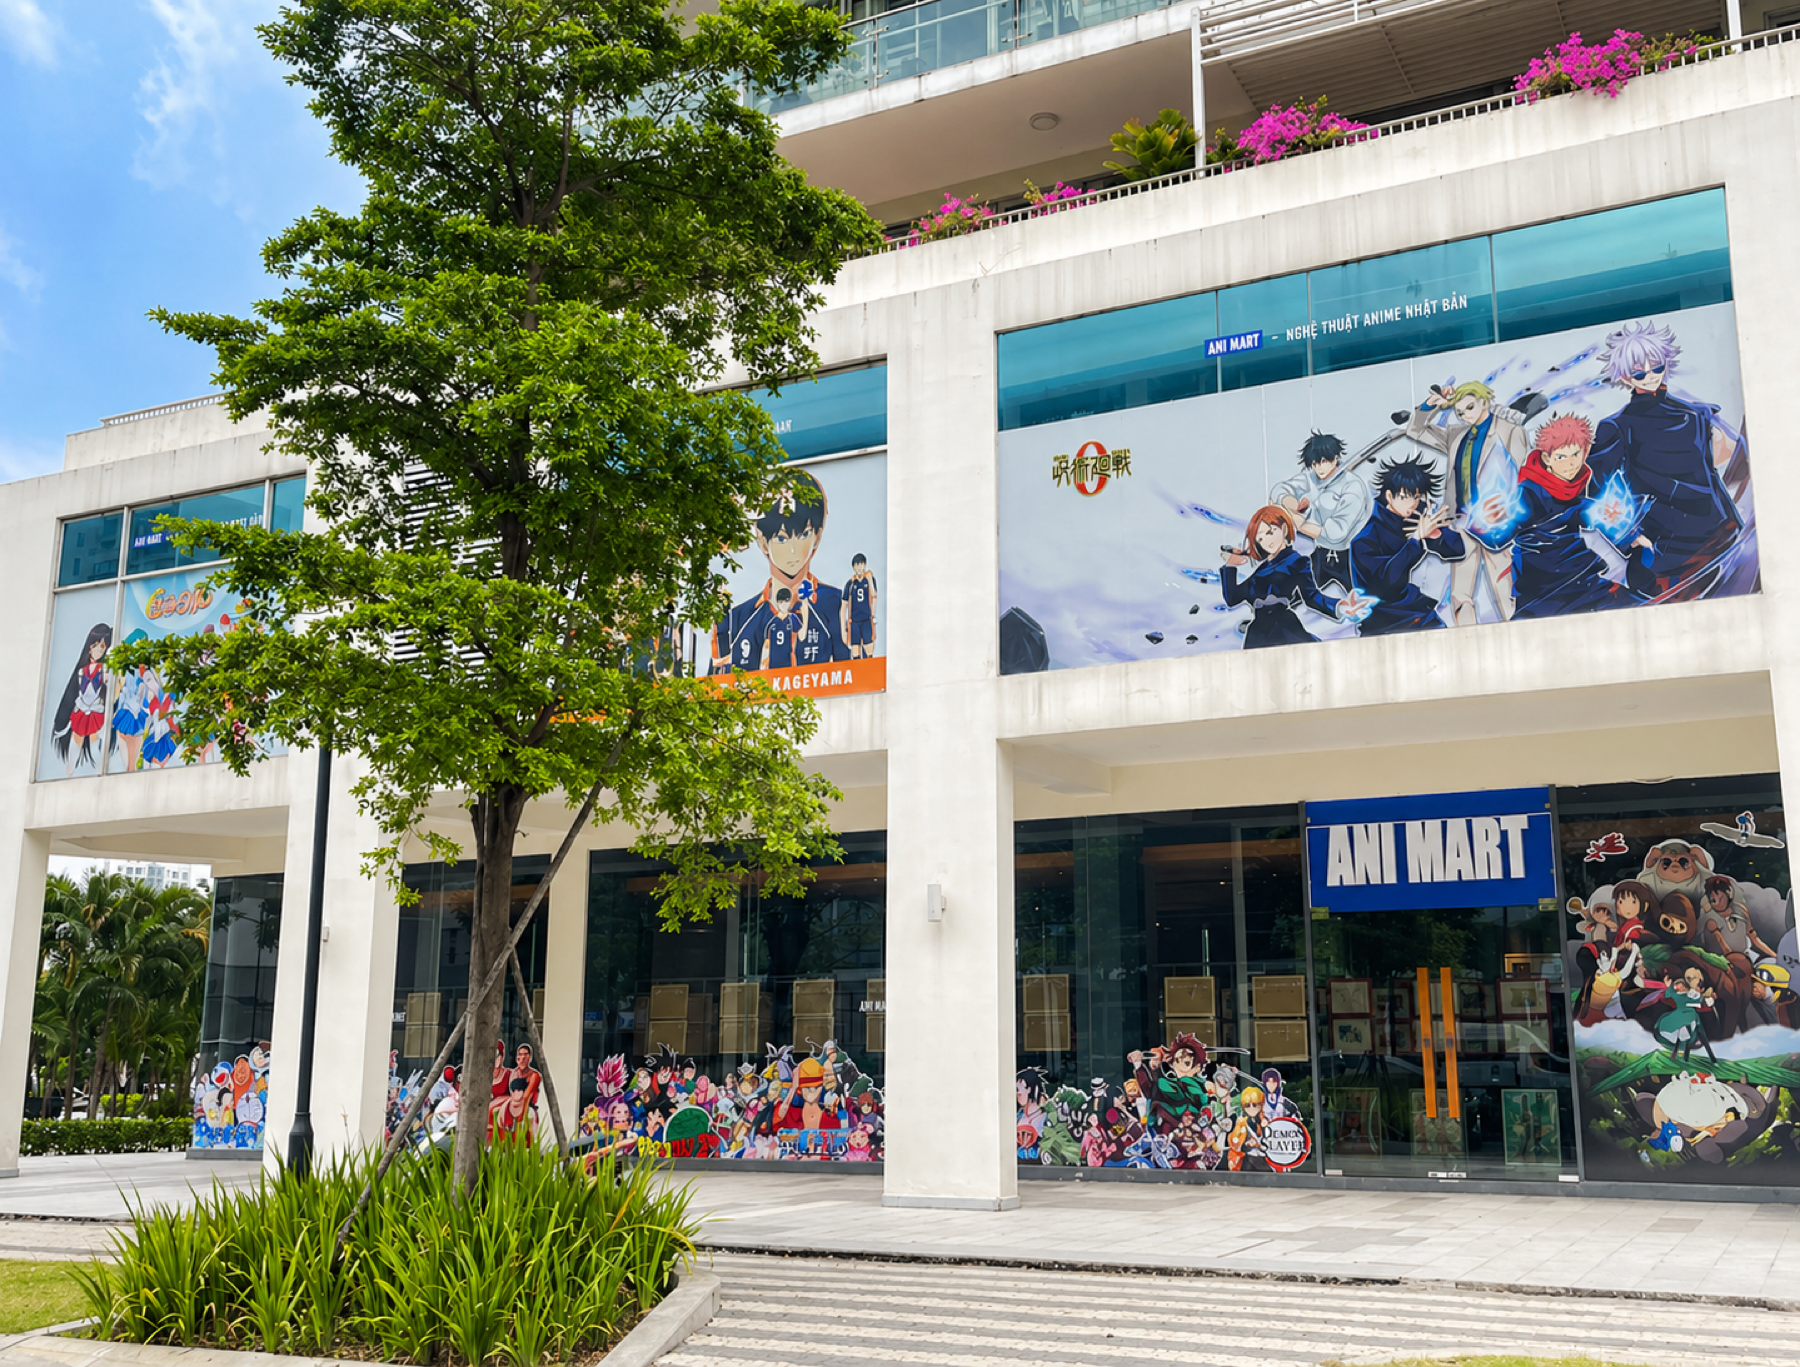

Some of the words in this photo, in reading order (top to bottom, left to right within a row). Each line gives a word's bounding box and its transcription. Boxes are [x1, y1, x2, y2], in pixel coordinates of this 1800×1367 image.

[1207, 338, 1227, 355] ANI
[1230, 333, 1260, 351] MART
[1286, 320, 1318, 341] NGHỆ
[1321, 314, 1360, 334] THUẬT
[1363, 306, 1402, 327] ANIME
[1405, 298, 1438, 319] NHẬT
[776, 630, 785, 645] 9
[772, 669, 853, 692] KAGEYAMA
[1326, 822, 1398, 888] ANI
[1405, 813, 1529, 884] MART
